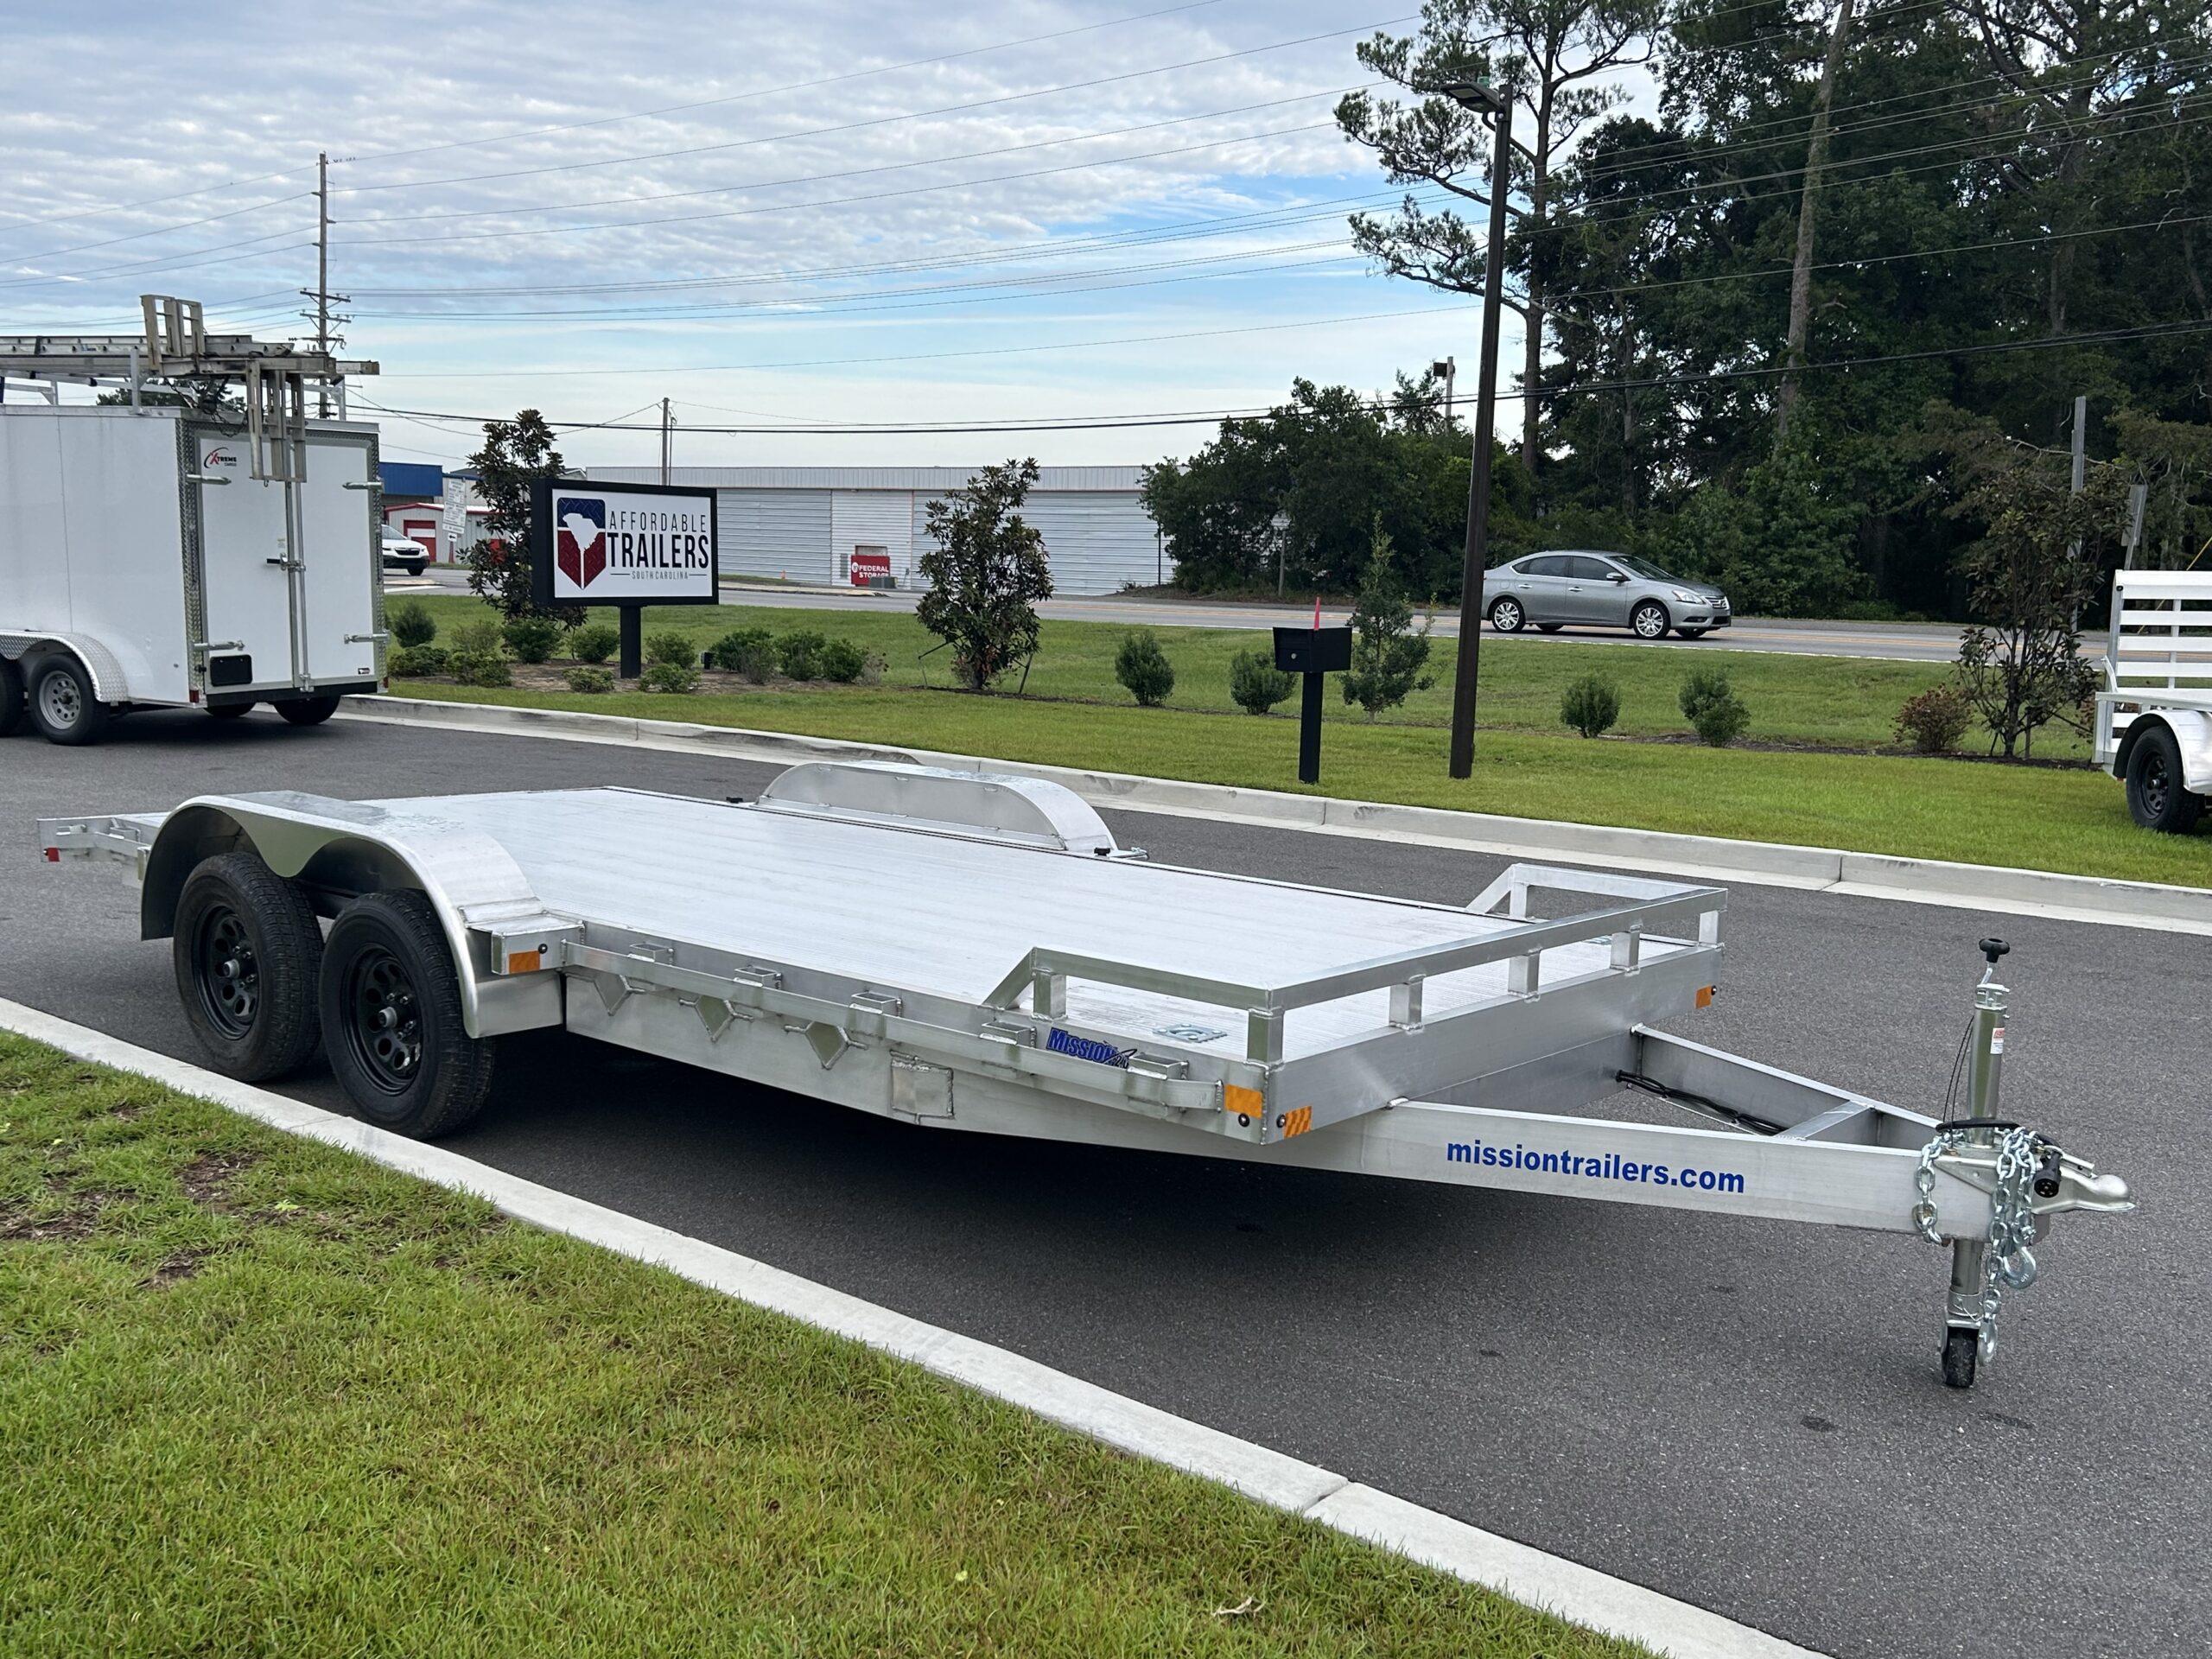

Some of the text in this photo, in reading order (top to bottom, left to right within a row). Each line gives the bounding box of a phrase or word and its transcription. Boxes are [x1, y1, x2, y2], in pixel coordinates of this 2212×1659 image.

[609, 511, 706, 533] AFFORDABLE
[607, 531, 709, 569] TRAILERS
[632, 570, 689, 580] SOUTH CAROLINA
[859, 564, 889, 573] FEDERAL
[1446, 1139, 1745, 1193] missiontrailers.com
